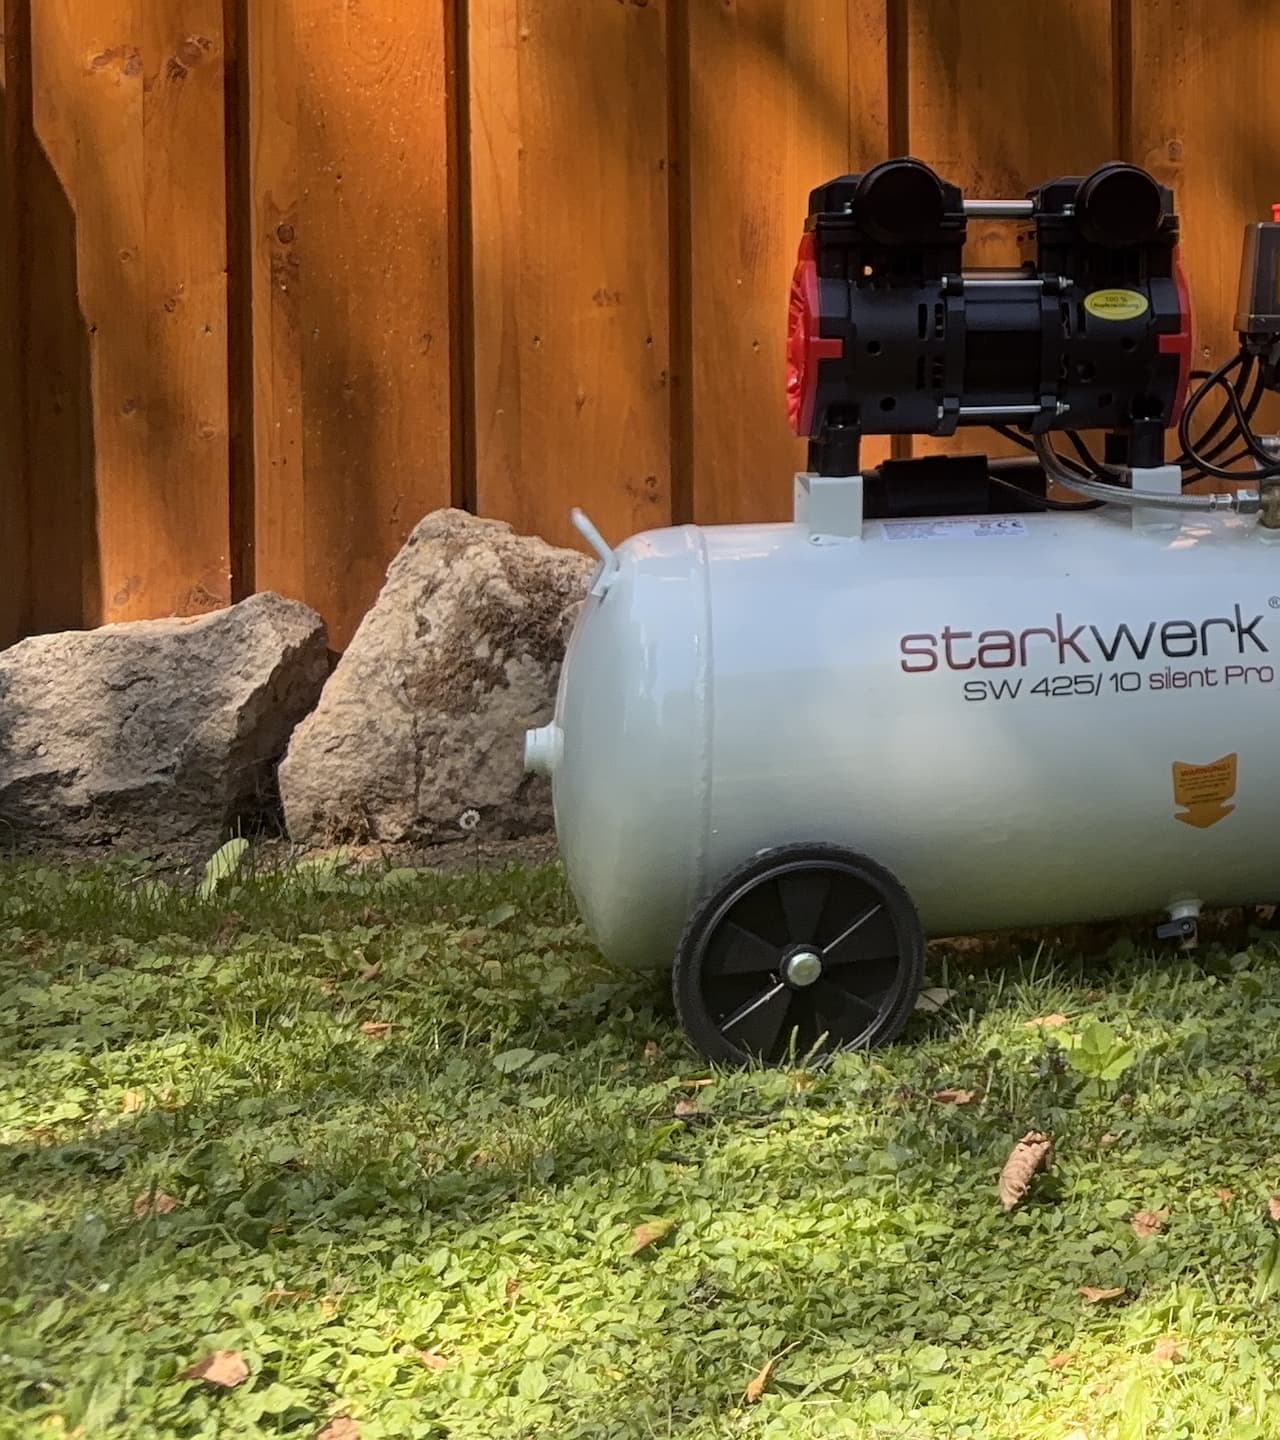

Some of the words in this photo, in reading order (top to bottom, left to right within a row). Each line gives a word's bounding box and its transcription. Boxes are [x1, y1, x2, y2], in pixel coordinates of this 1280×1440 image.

[963, 678, 1023, 702] SW
[1149, 666, 1218, 691] silent
[1225, 665, 1275, 686] Pro
